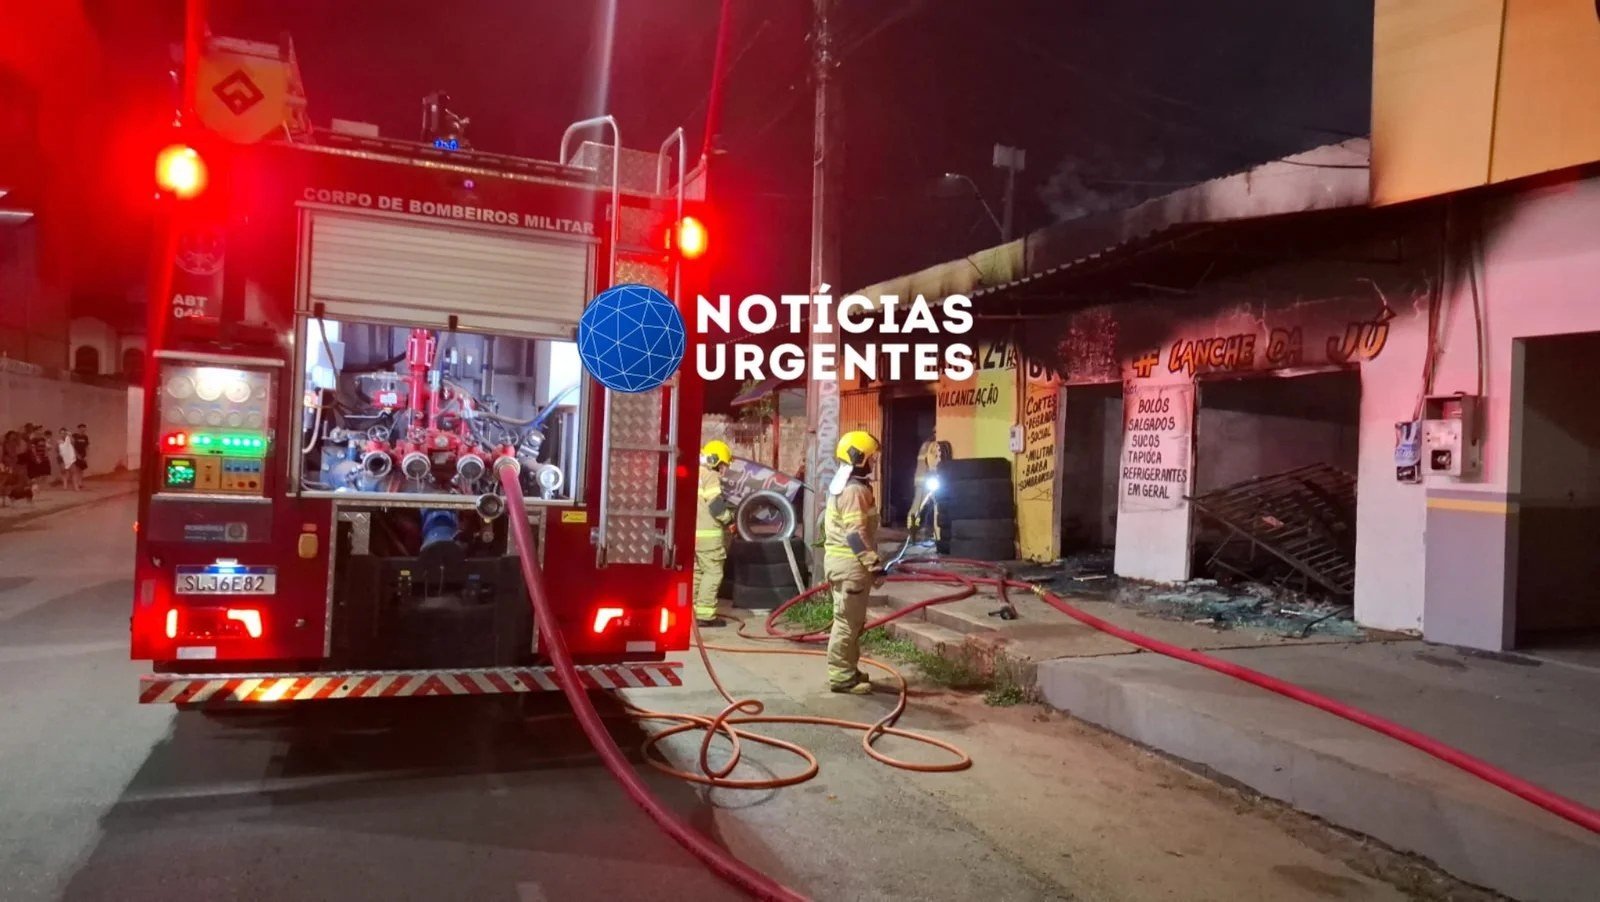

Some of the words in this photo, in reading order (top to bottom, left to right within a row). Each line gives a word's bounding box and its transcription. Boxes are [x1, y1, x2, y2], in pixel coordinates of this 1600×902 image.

[303, 187, 372, 207] CORPO
[378, 196, 403, 211] DE
[409, 200, 519, 225] BOMBEIROS
[524, 214, 595, 234] MILITAR
[172, 293, 208, 307] ABT
[1168, 334, 1256, 376] LANCHE
[938, 383, 999, 408] VULCANIZAÇÃO
[1138, 397, 1170, 414] BOLOS
[1127, 416, 1175, 432] SALGADOS
[1131, 434, 1160, 448] SUCOS
[1127, 450, 1162, 465] TAPIOCA
[1122, 467, 1187, 483] REFRIGERANTES
[1127, 482, 1140, 496] EM
[1142, 484, 1170, 499] GERAL
[184, 575, 265, 592] SLJ6E82
